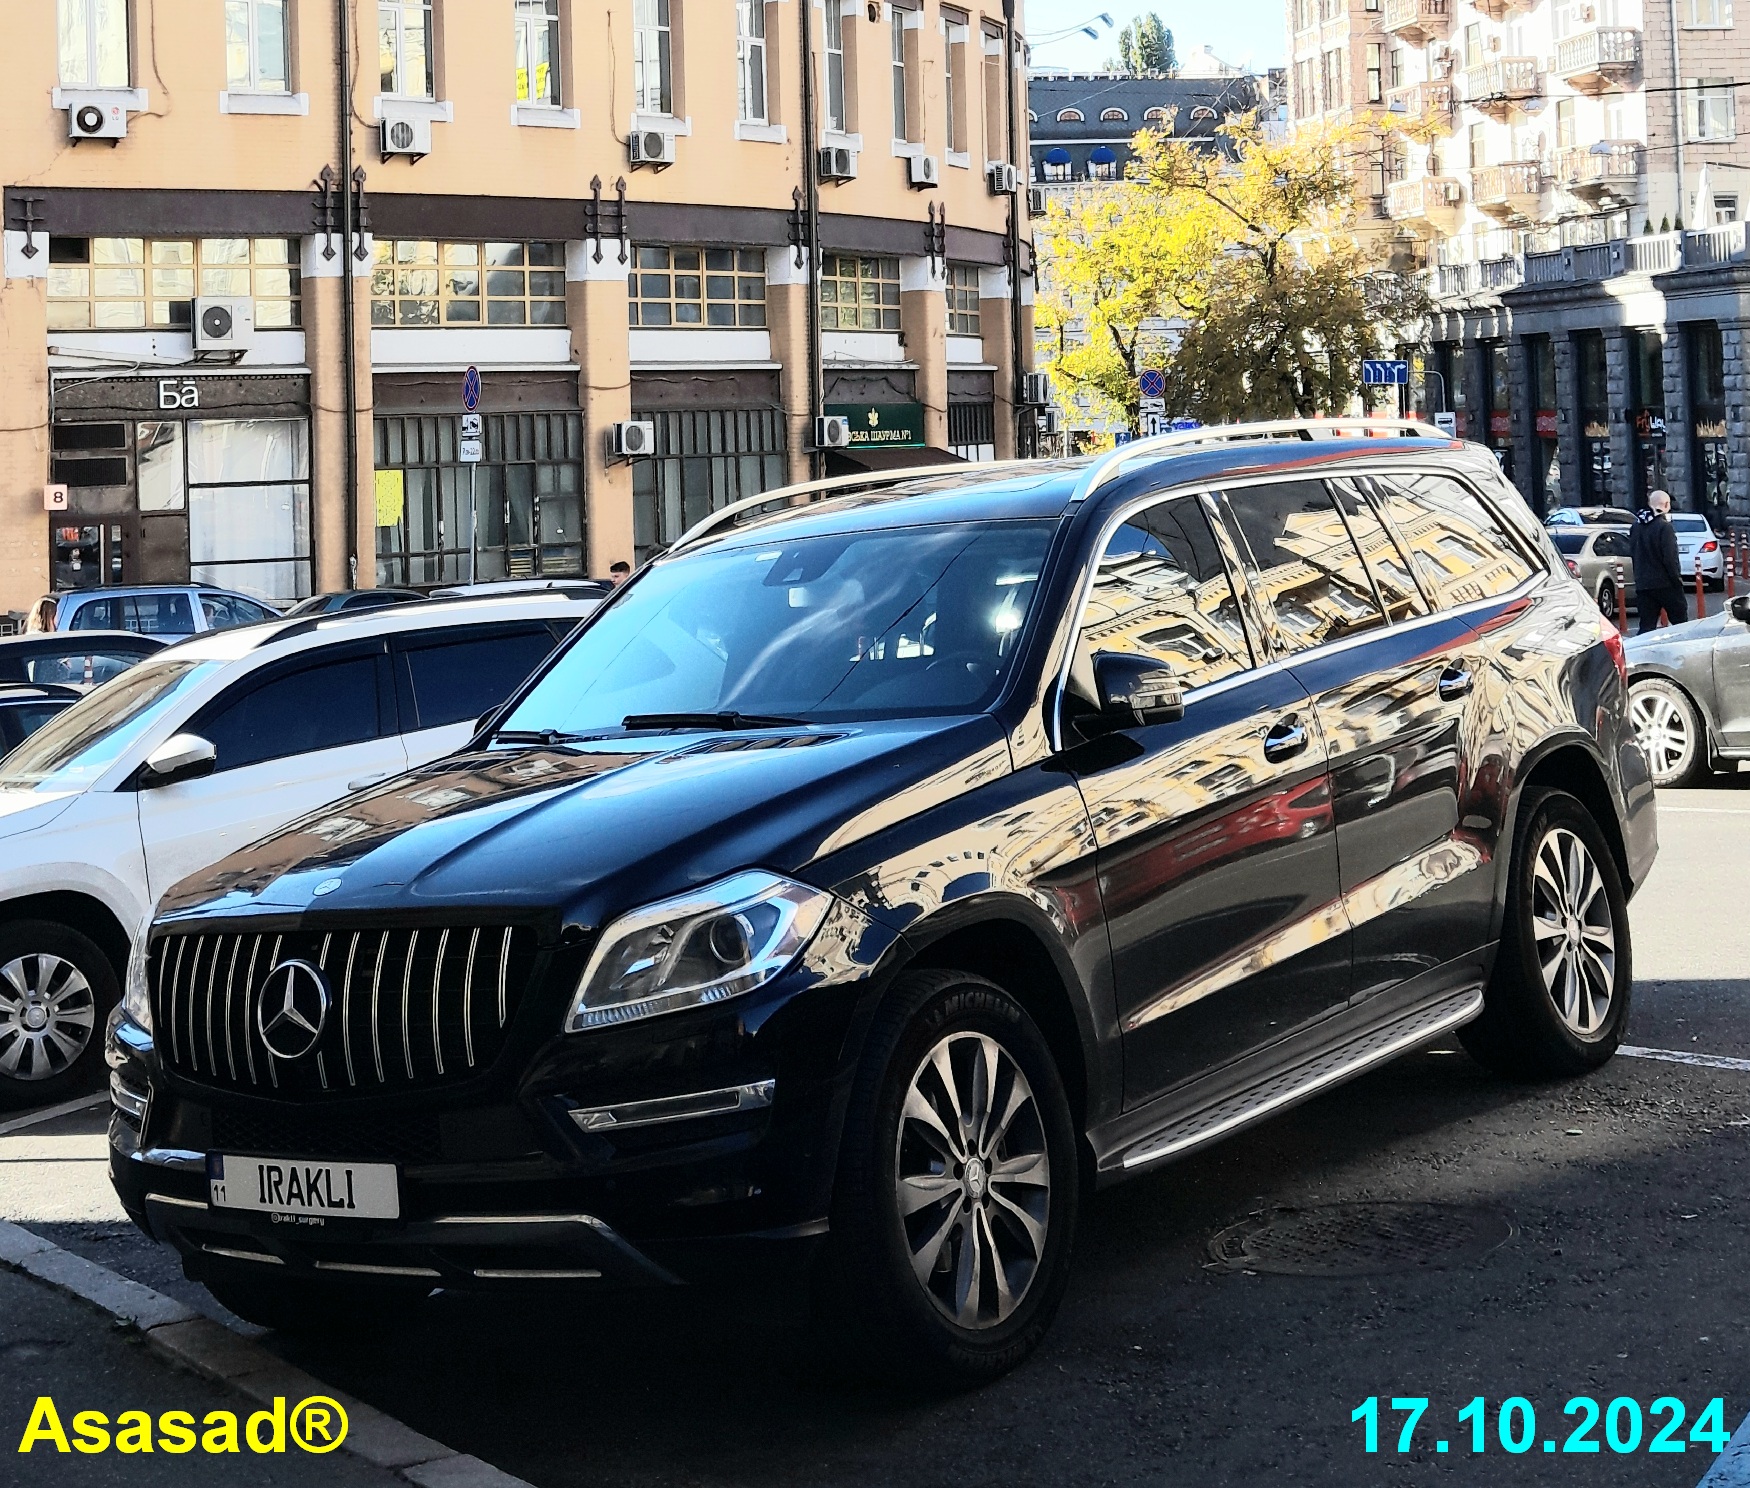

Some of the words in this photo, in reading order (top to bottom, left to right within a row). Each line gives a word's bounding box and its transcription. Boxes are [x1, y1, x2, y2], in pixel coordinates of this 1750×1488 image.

[871, 430, 900, 442] ШАУРМА
[53, 491, 64, 504] 8
[213, 1184, 227, 1202] 11
[258, 1164, 356, 1209] IRAKLI
